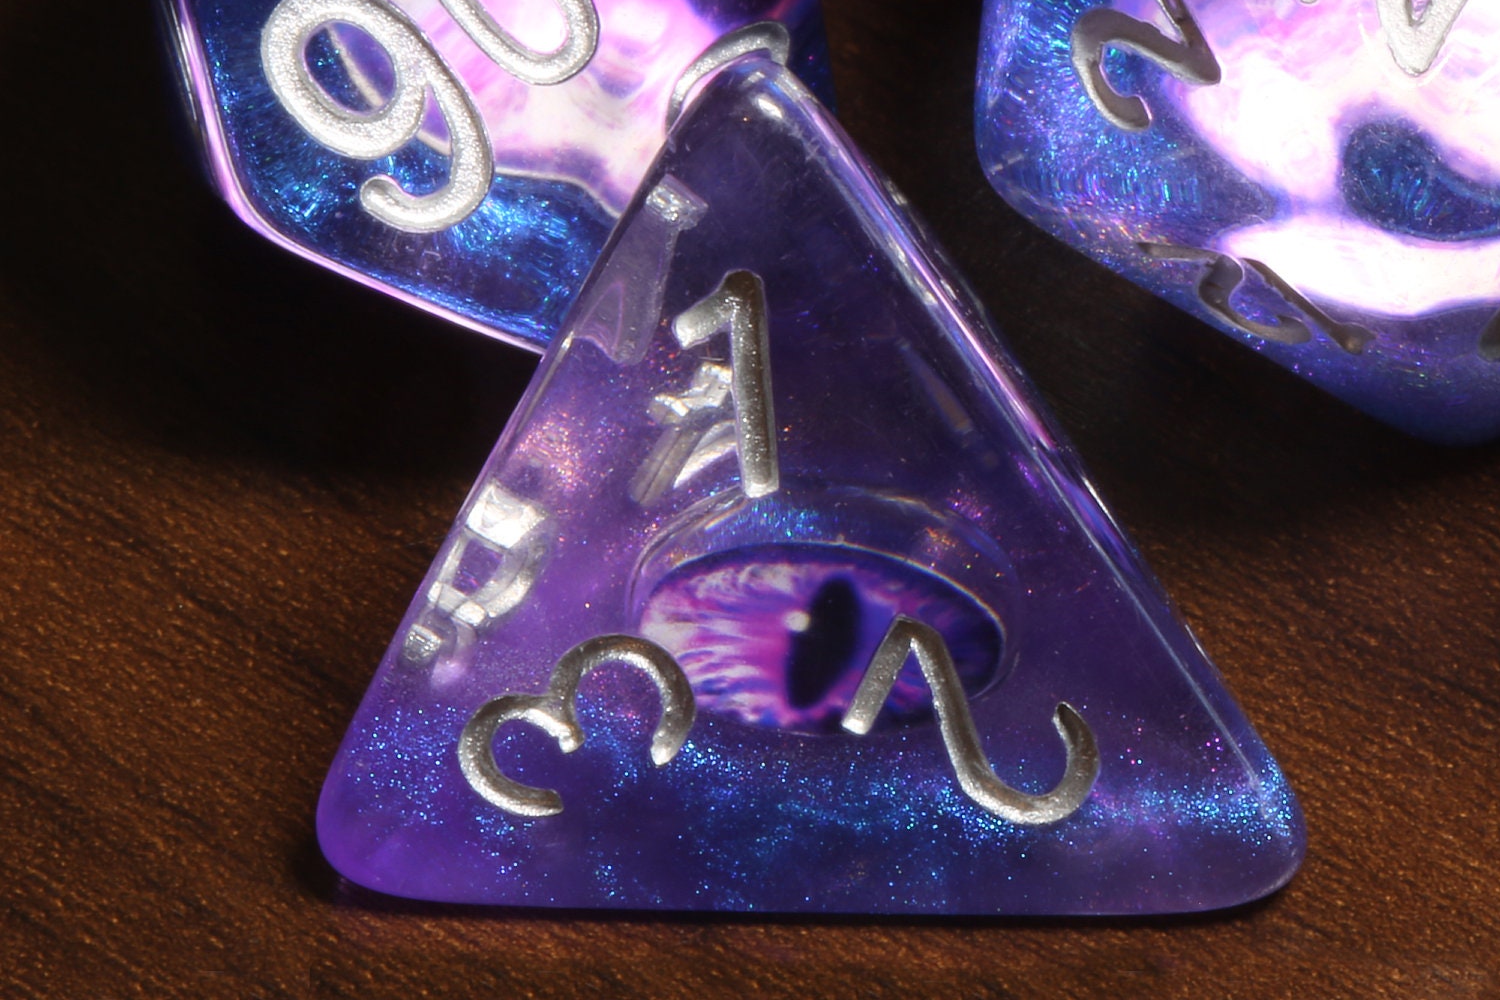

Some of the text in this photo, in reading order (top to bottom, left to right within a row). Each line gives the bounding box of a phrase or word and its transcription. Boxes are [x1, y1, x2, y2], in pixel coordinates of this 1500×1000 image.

[673, 269, 779, 499] 1
[457, 634, 696, 818] 3
[841, 613, 1100, 823] 2
